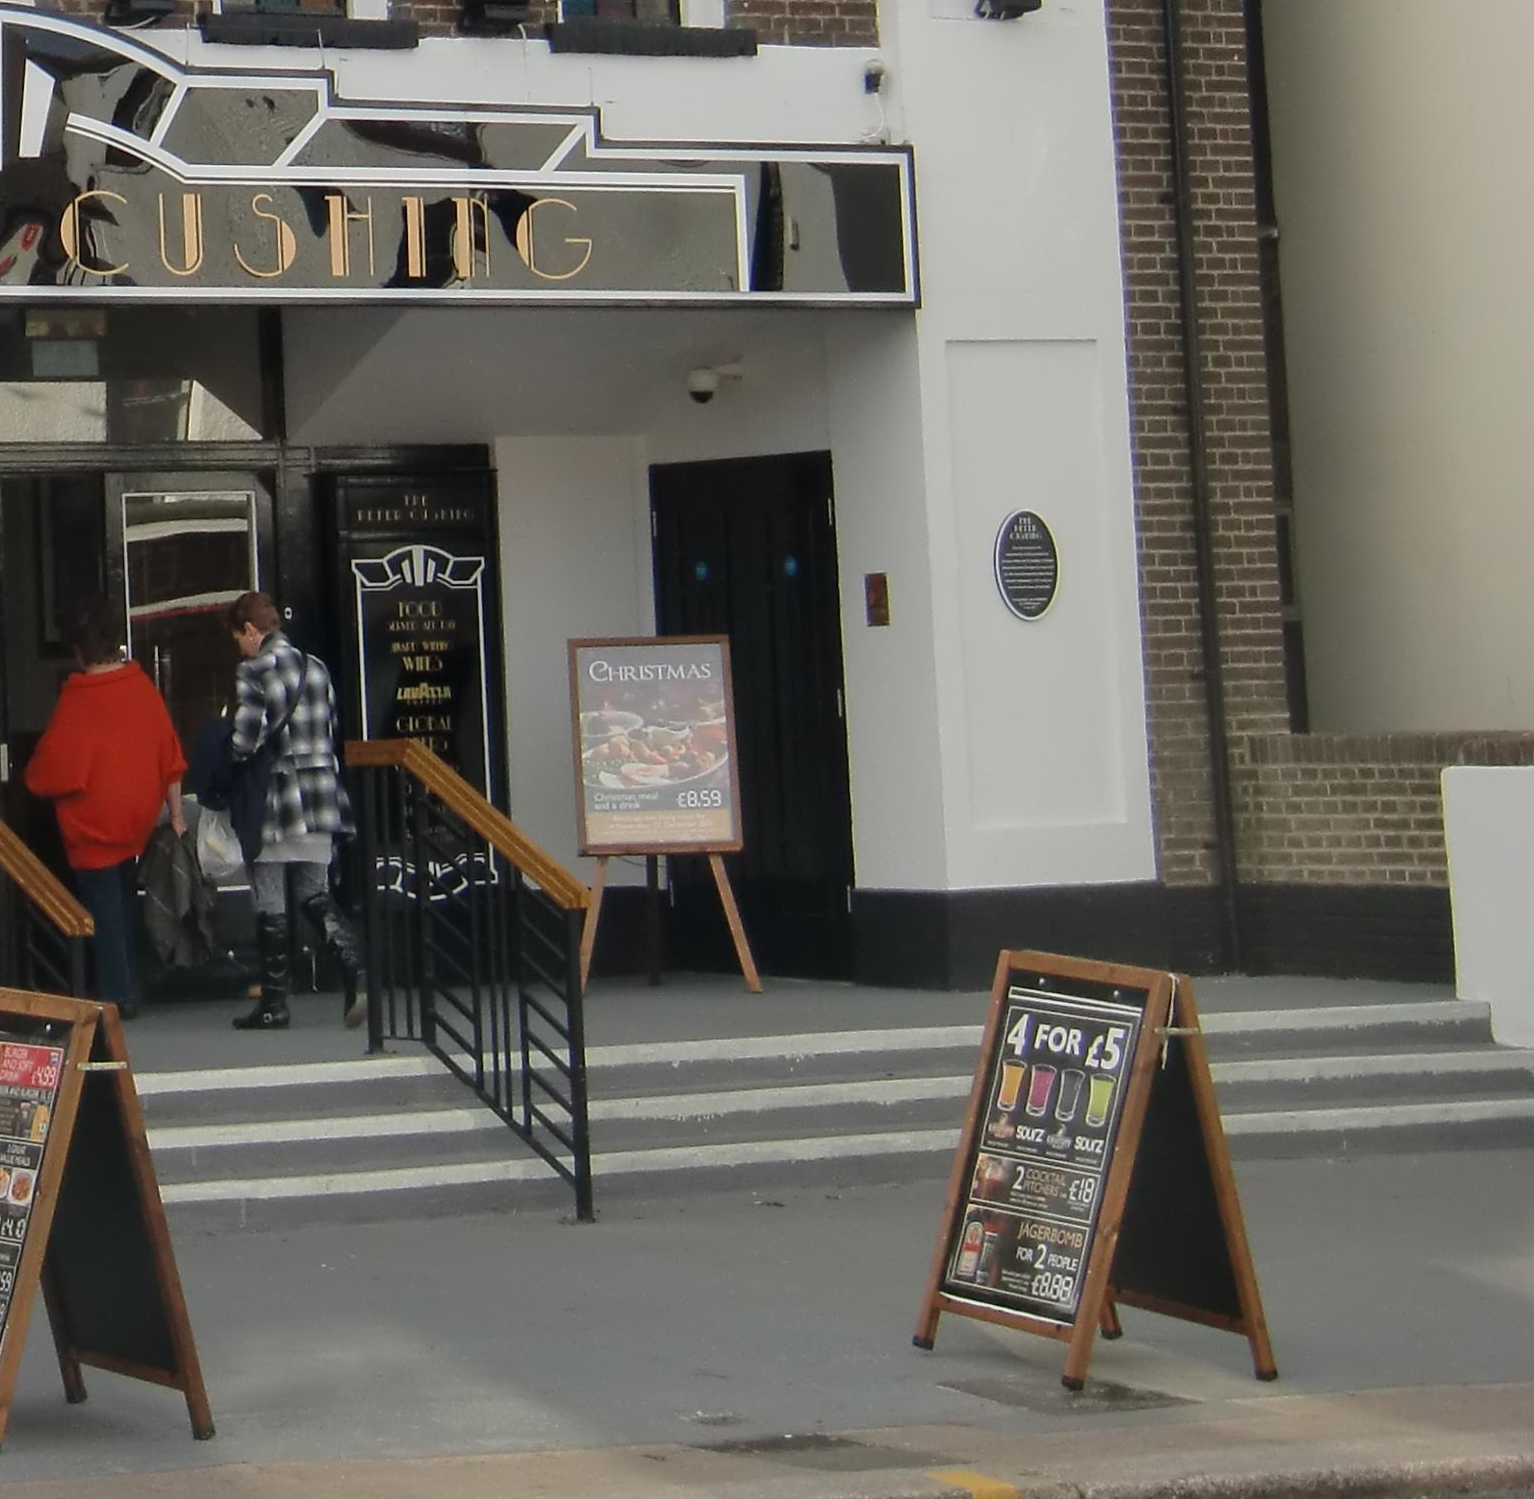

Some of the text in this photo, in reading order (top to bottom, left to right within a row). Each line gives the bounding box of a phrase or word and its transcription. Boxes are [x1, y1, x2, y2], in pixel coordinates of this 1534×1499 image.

[61, 187, 596, 284] CUSHING
[589, 660, 712, 681] CHRISTMAS
[676, 790, 722, 808] £8.59
[1007, 1013, 1125, 1070] 4 FOR £5
[1012, 1166, 1024, 1190] 2
[1069, 1178, 1095, 1202] £18
[1016, 1243, 1079, 1271] FOR 2 PEOPLE
